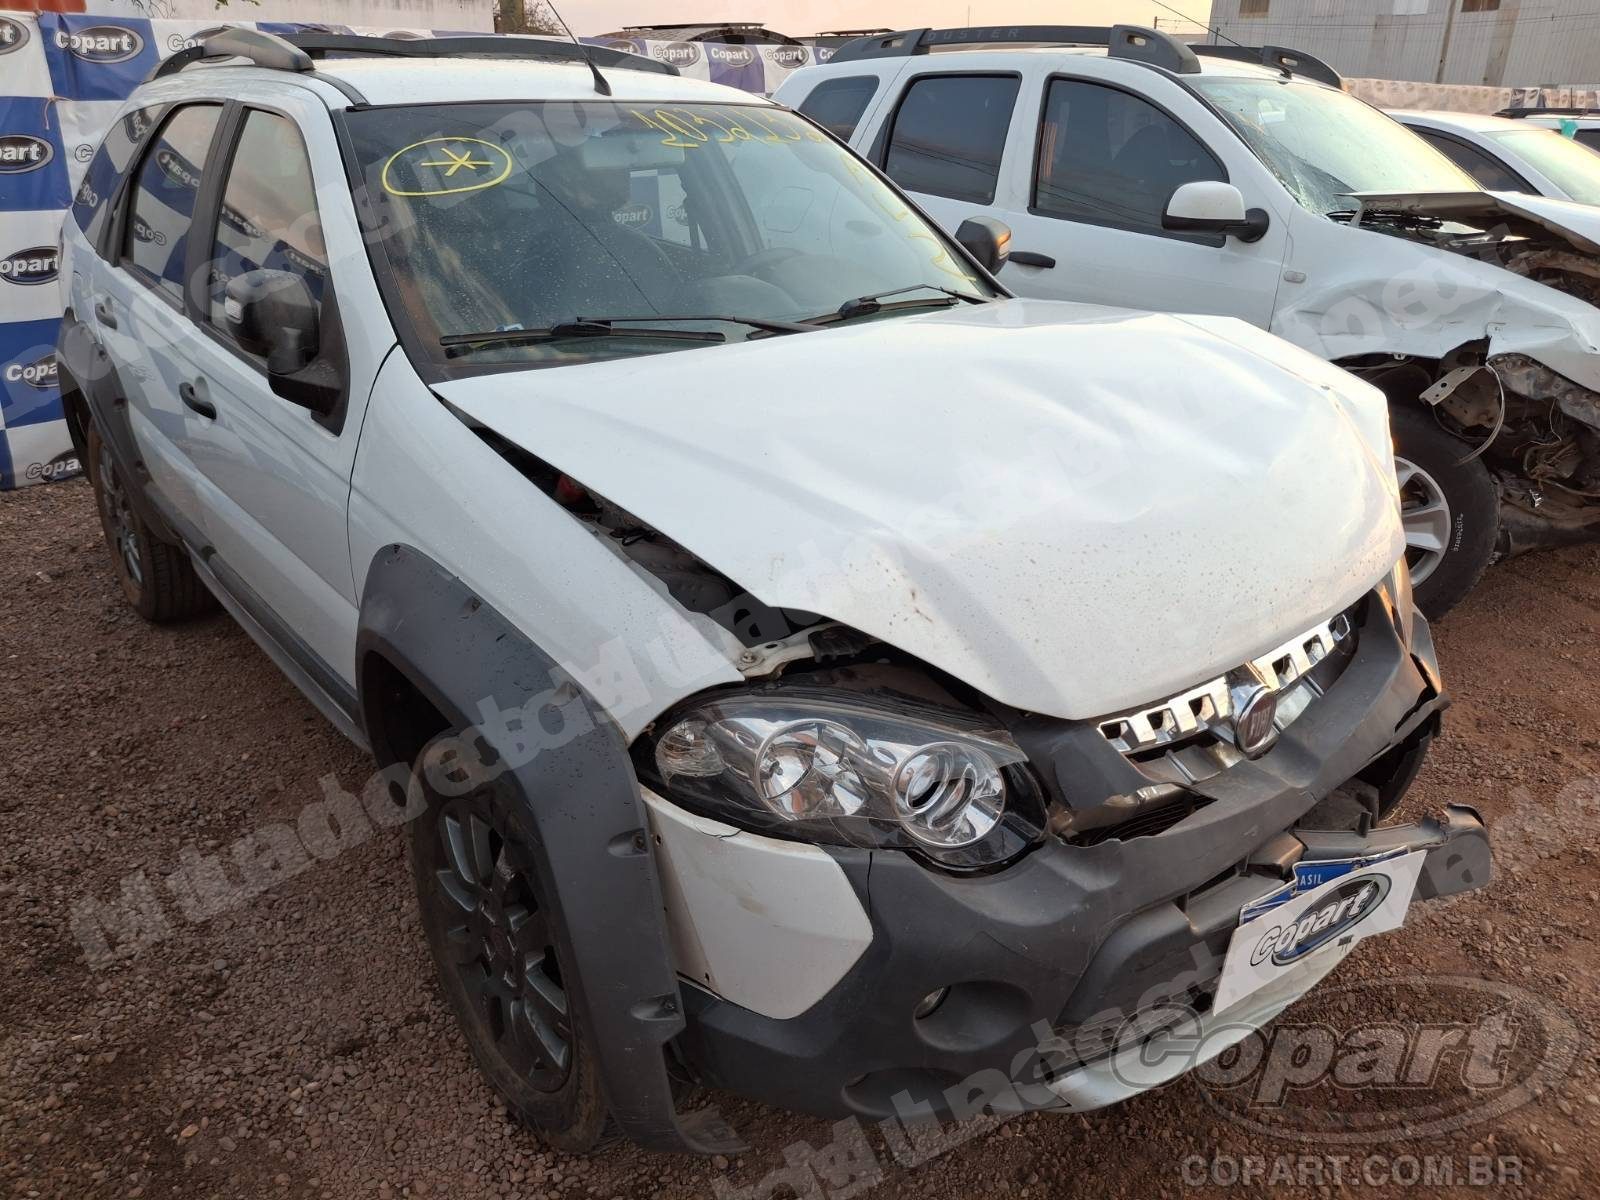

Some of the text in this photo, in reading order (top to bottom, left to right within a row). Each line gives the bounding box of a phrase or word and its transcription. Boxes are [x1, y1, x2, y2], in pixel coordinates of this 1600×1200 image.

[55, 30, 131, 54] Copart
[927, 28, 1021, 41] DUSTER
[653, 44, 695, 61] Copart
[710, 47, 750, 61] Copart
[765, 48, 804, 63] Copart
[0, 142, 40, 161] art
[0, 256, 58, 277] opar
[6, 362, 58, 383] Copa
[26, 458, 82, 480] Copa
[1296, 873, 1324, 887] ASIL
[1250, 880, 1377, 967] Copart
